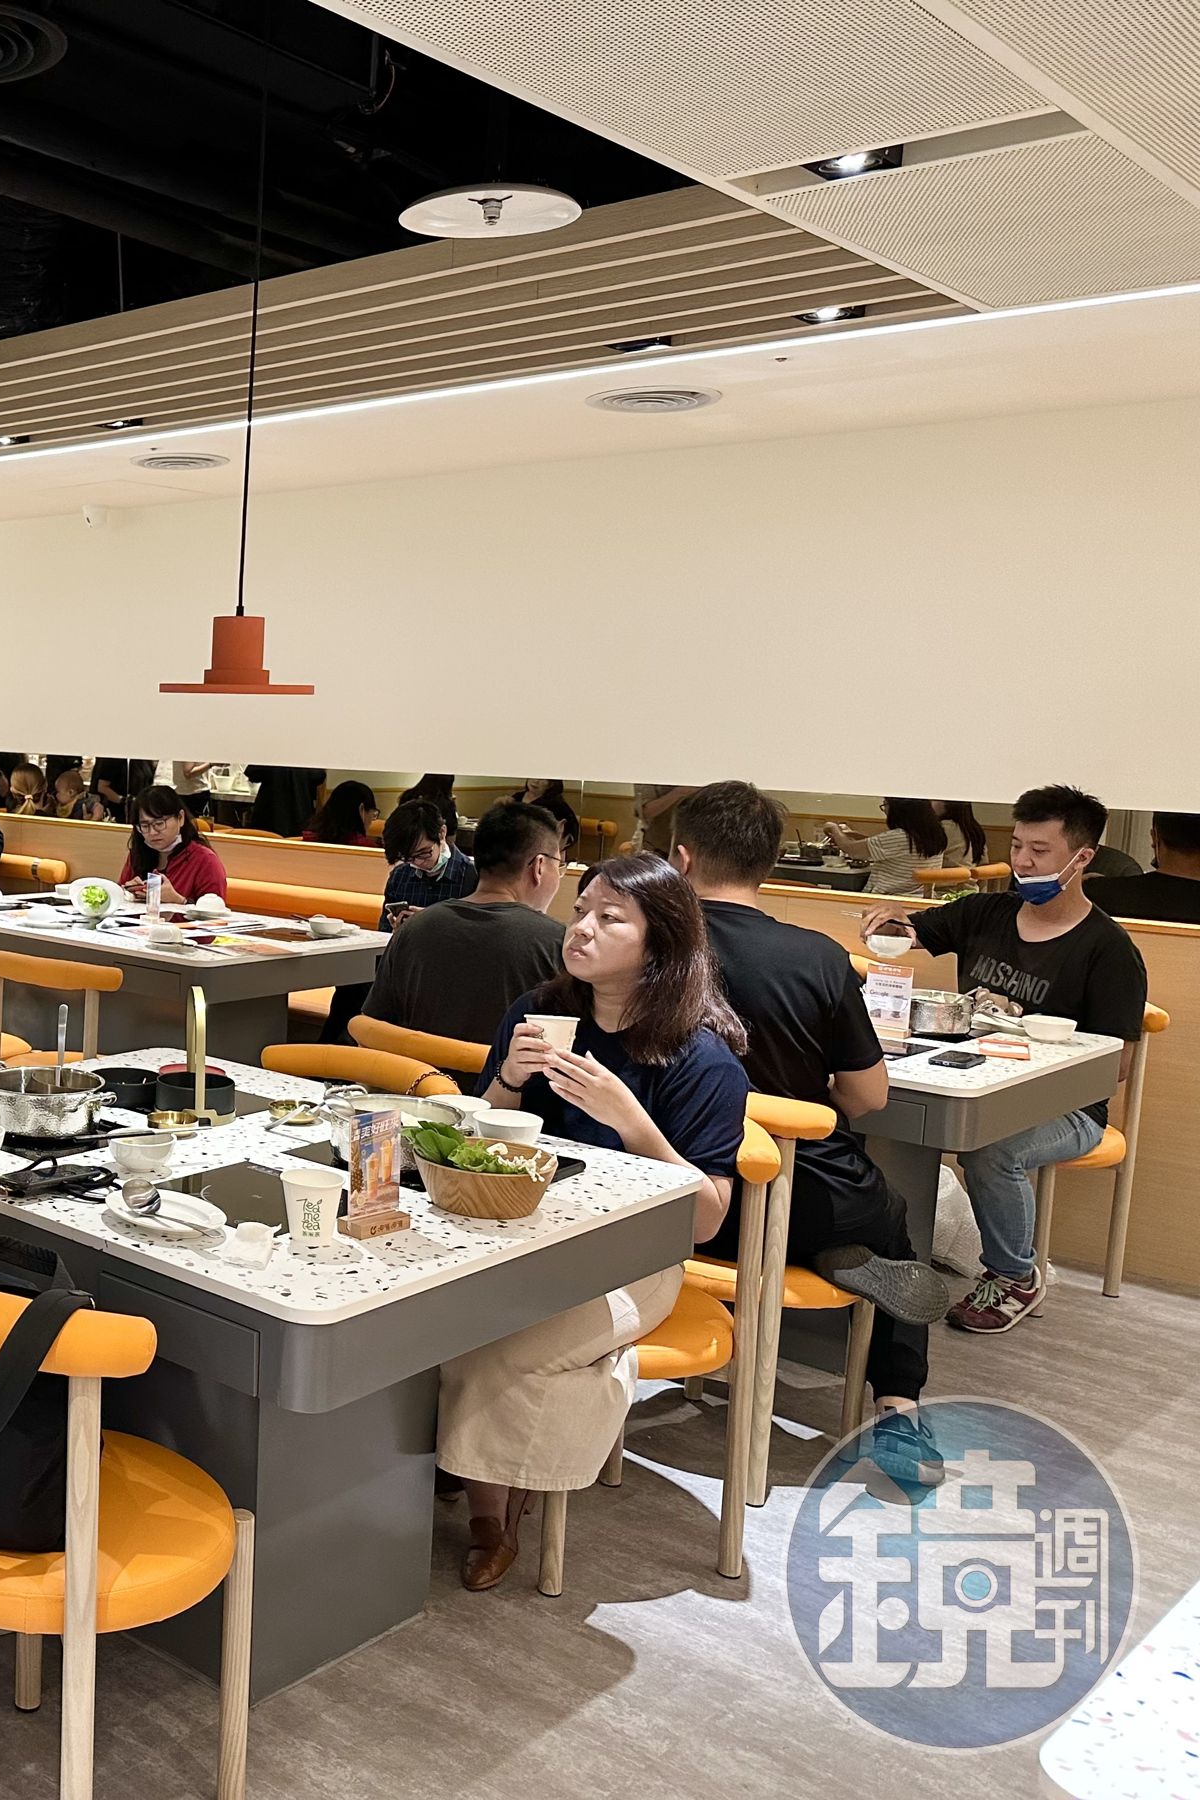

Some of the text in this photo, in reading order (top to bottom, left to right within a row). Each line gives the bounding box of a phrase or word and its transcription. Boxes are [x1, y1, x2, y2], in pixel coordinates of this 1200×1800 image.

[296, 1198, 322, 1213] Tea
[303, 1212, 321, 1222] me
[301, 1220, 321, 1231] tea
[1000, 1296, 1025, 1319] N
